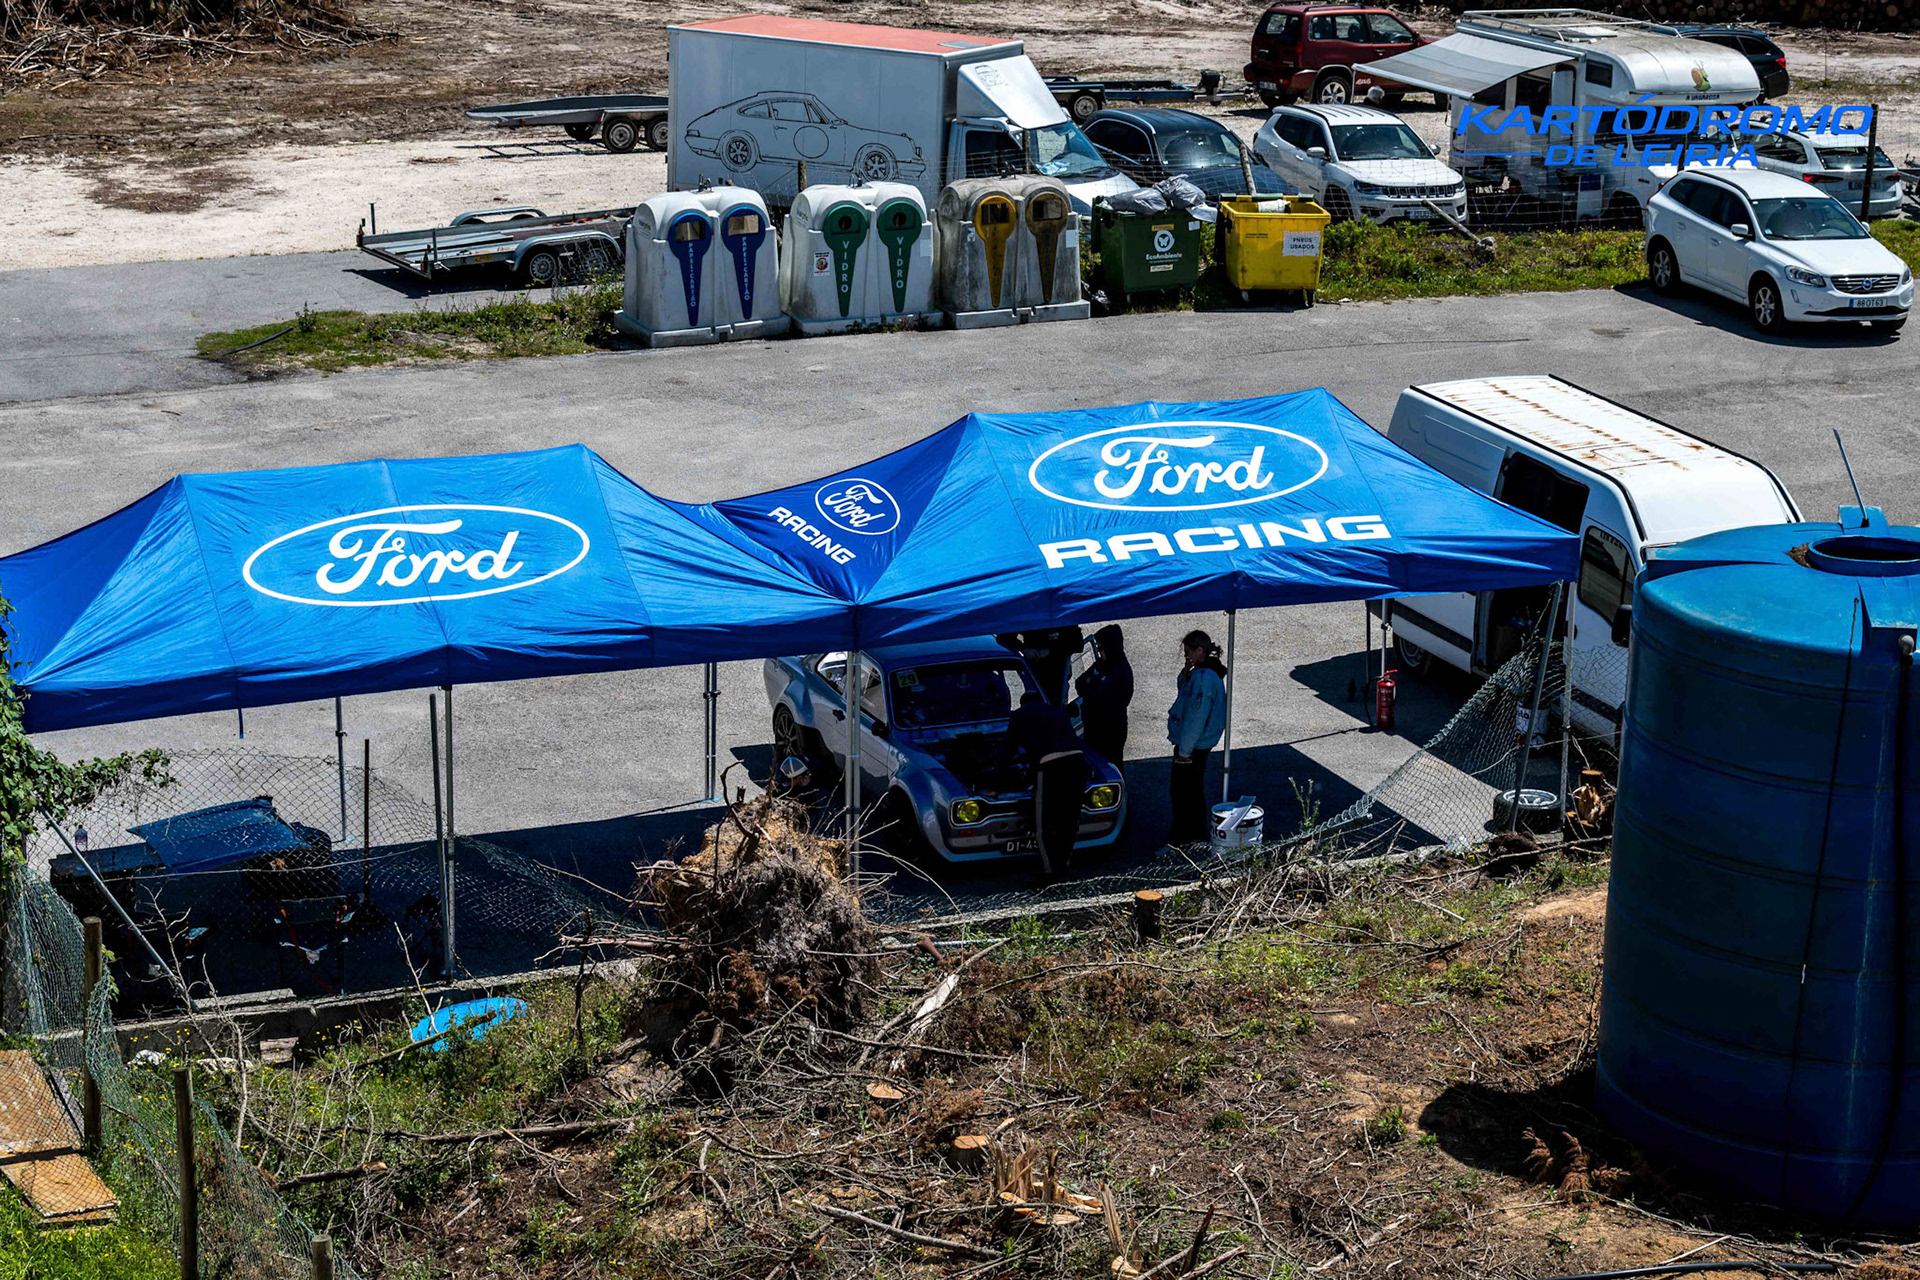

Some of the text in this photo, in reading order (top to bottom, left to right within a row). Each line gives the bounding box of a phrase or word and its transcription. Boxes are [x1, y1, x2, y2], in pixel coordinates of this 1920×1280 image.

[841, 241, 850, 293] VIDRO
[896, 237, 904, 289] VIDRO
[1093, 434, 1274, 498] Ford
[823, 484, 886, 527] Ford
[316, 519, 524, 594] Ford
[767, 506, 857, 565] RACING
[1039, 515, 1392, 569] RACING
